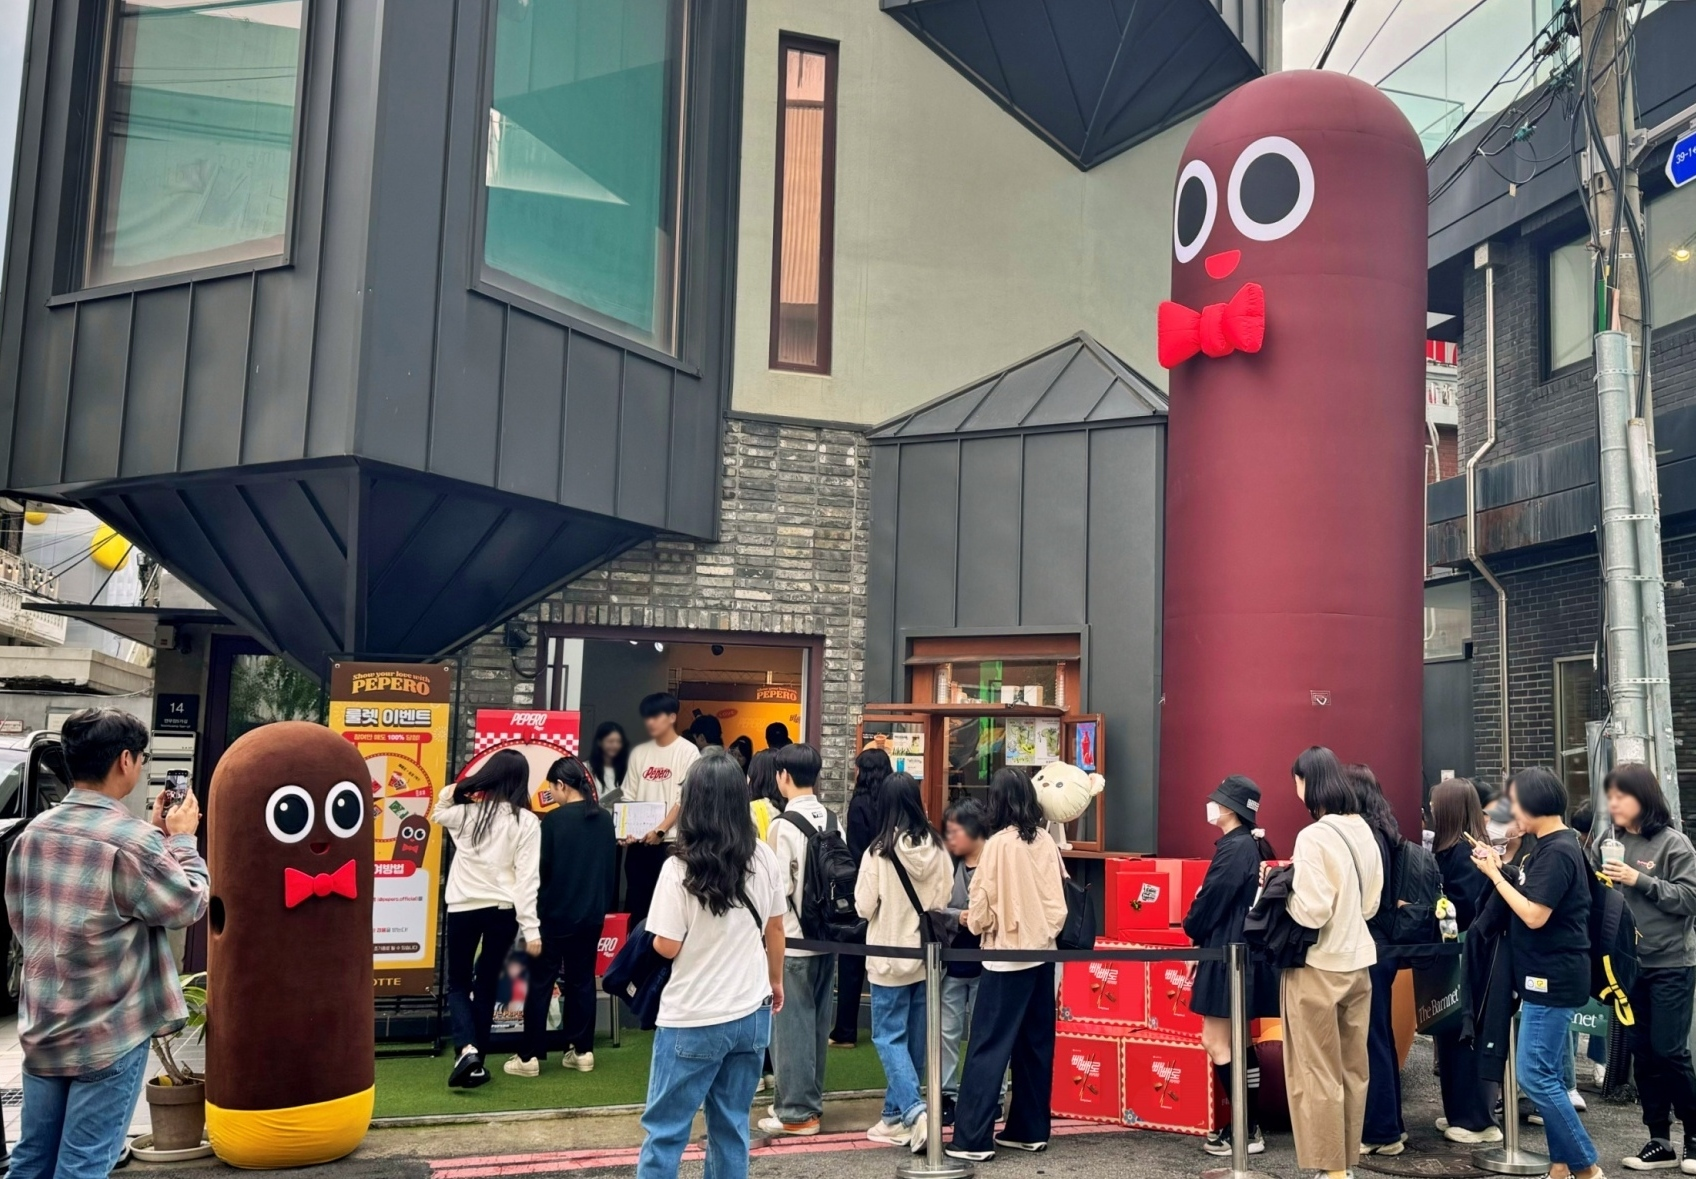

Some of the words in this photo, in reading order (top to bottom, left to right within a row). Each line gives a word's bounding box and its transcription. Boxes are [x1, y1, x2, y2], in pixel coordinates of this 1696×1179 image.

[351, 677, 430, 695] PEPERO
[756, 690, 797, 702] PEPERO
[170, 703, 185, 714] 14
[345, 707, 379, 727] 룰렛
[382, 708, 432, 728] 이벤트
[510, 713, 548, 726] PEPERO
[1089, 962, 1118, 981] 빼빼로
[1418, 1005, 1431, 1023] The
[1071, 1054, 1101, 1075] 빼빼로
[1151, 1061, 1182, 1081] 빼빼로
